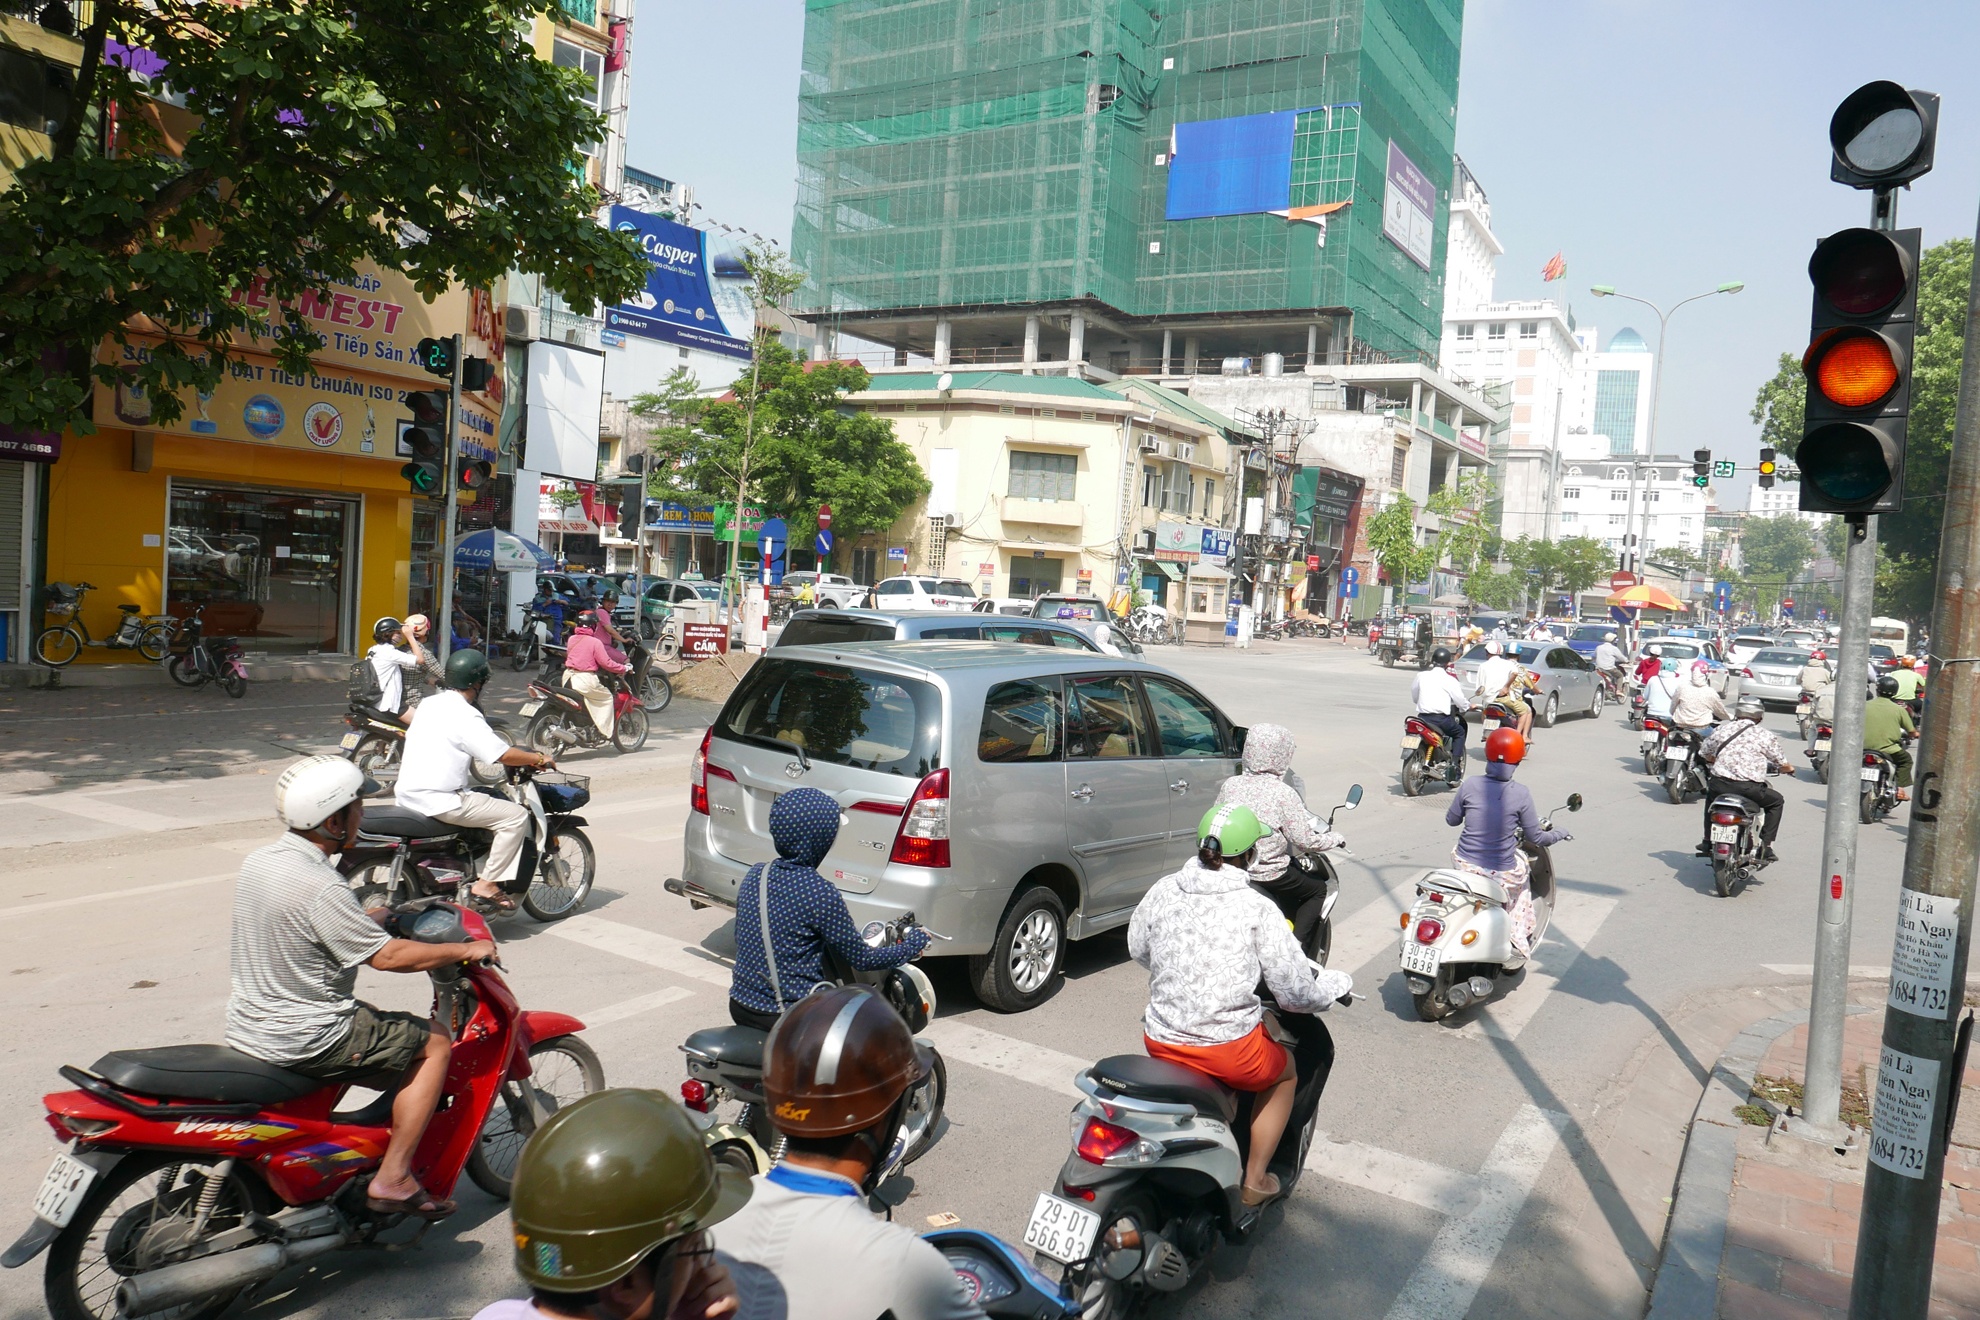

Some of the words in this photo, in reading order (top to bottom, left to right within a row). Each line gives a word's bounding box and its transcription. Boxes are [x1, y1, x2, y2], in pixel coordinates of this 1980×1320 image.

[642, 233, 697, 265] Casper
[353, 274, 382, 293] CẤP
[334, 331, 369, 358] Tiếp
[375, 341, 403, 362] Sản
[231, 364, 264, 382] ĐẠT
[311, 375, 364, 397] CHUẨN
[369, 385, 393, 401] ISO
[22, 443, 52, 453] 4668
[1715, 462, 1734, 477] 23
[456, 547, 491, 558] PLUS
[693, 638, 717, 652] CẤM
[1916, 897, 1933, 915] Là
[1919, 920, 1954, 941] Ngay
[1408, 943, 1436, 961] 30-F9
[1918, 948, 1931, 957] Hà
[1406, 957, 1433, 973] 1838
[1895, 979, 1917, 1005] 684
[1922, 986, 1947, 1010] 732
[1896, 1056, 1913, 1075] Là
[1101, 1077, 1127, 1089] PIAGGIO
[1899, 1079, 1930, 1102] Ngay
[174, 1115, 259, 1134] Wave
[212, 1133, 251, 1141] 110
[1875, 1136, 1895, 1162] 684
[1900, 1145, 1924, 1170] 732
[1041, 1199, 1089, 1236] 29-D1
[1027, 1223, 1086, 1260] 566.93
